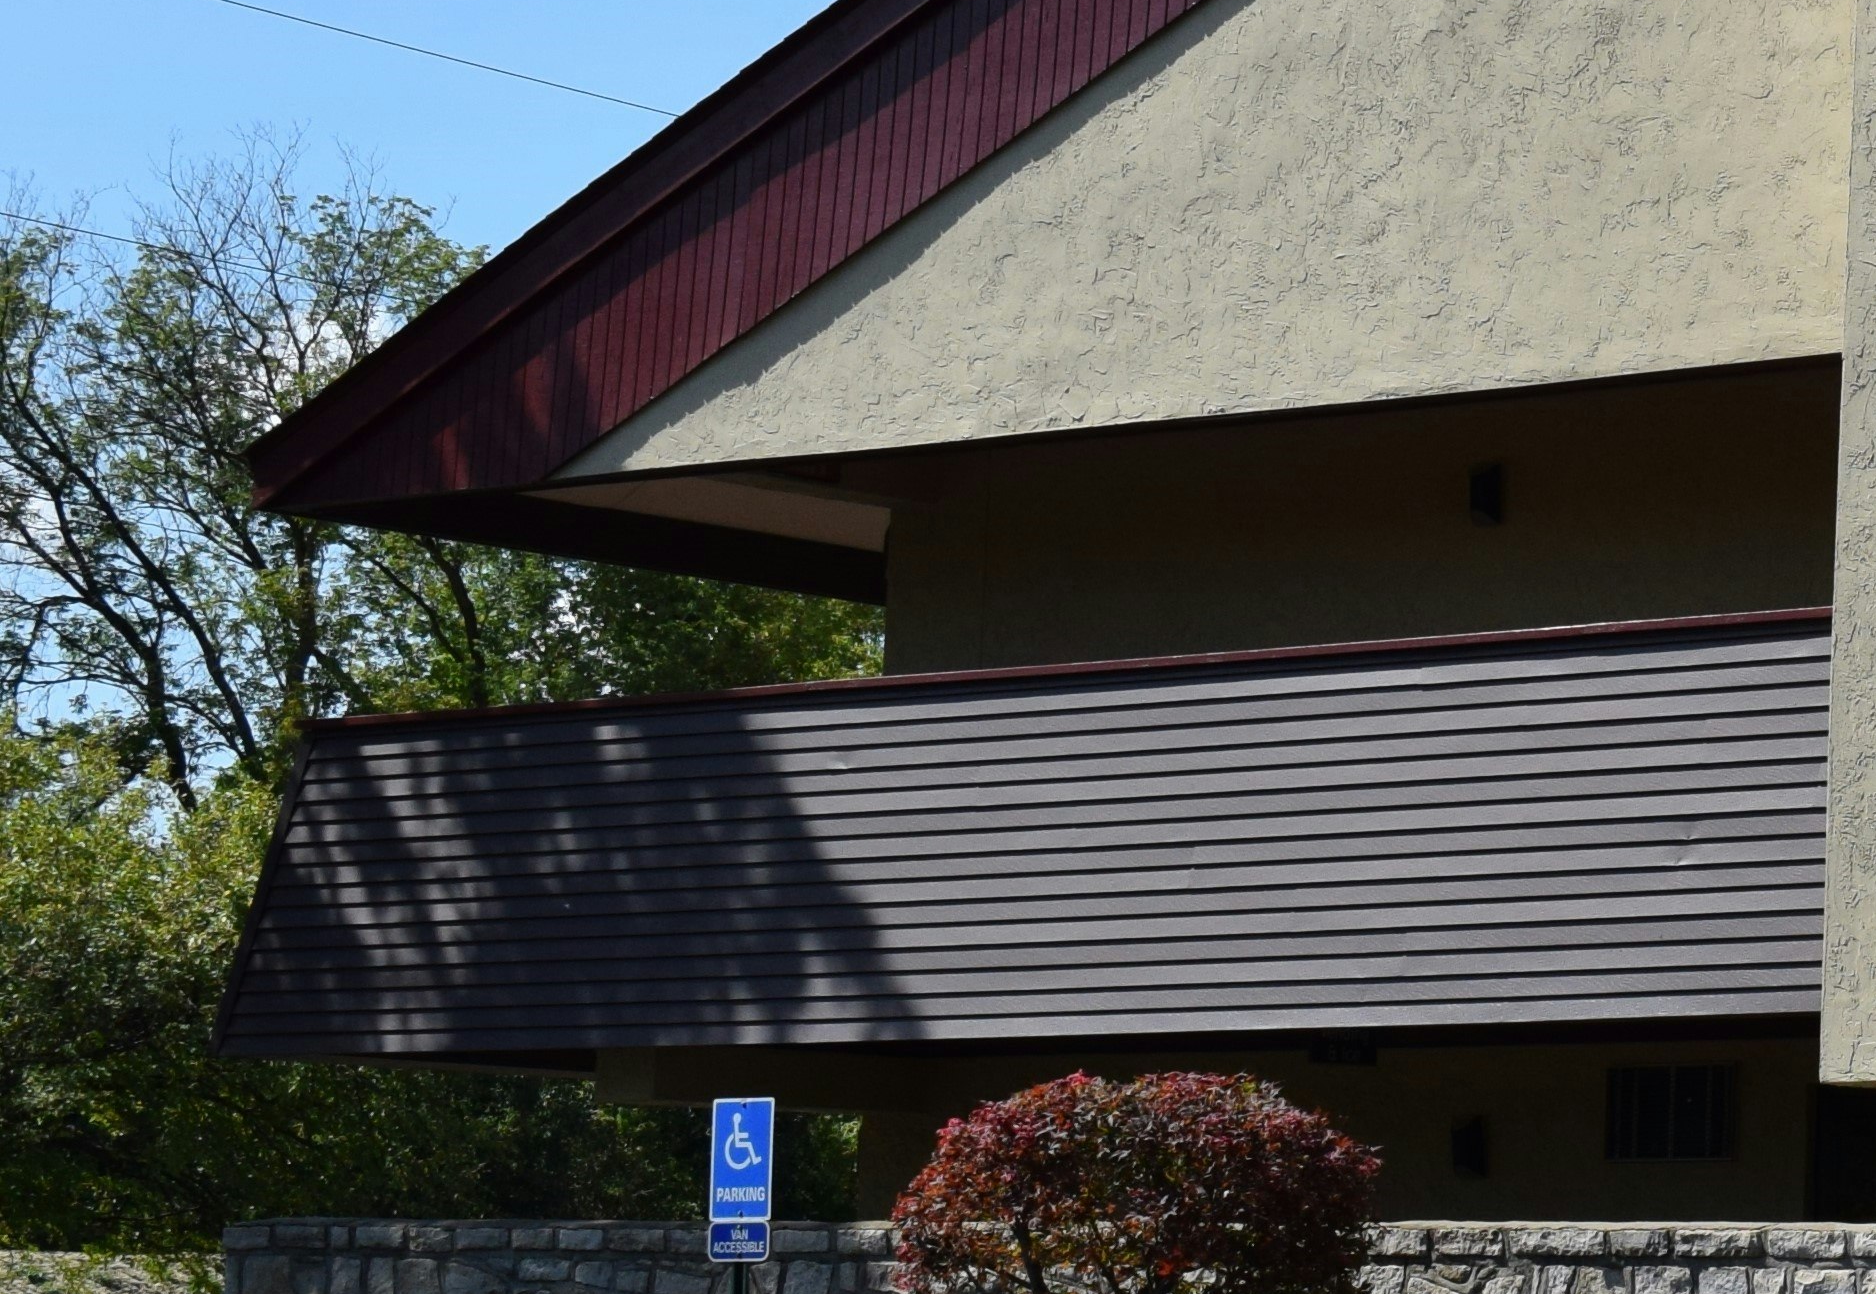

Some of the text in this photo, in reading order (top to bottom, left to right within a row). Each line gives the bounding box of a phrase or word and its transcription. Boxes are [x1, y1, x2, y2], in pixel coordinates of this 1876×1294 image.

[716, 1186, 766, 1203] PARKING
[731, 1229, 749, 1240] VAN
[713, 1241, 765, 1254] ACCESSIBLE
